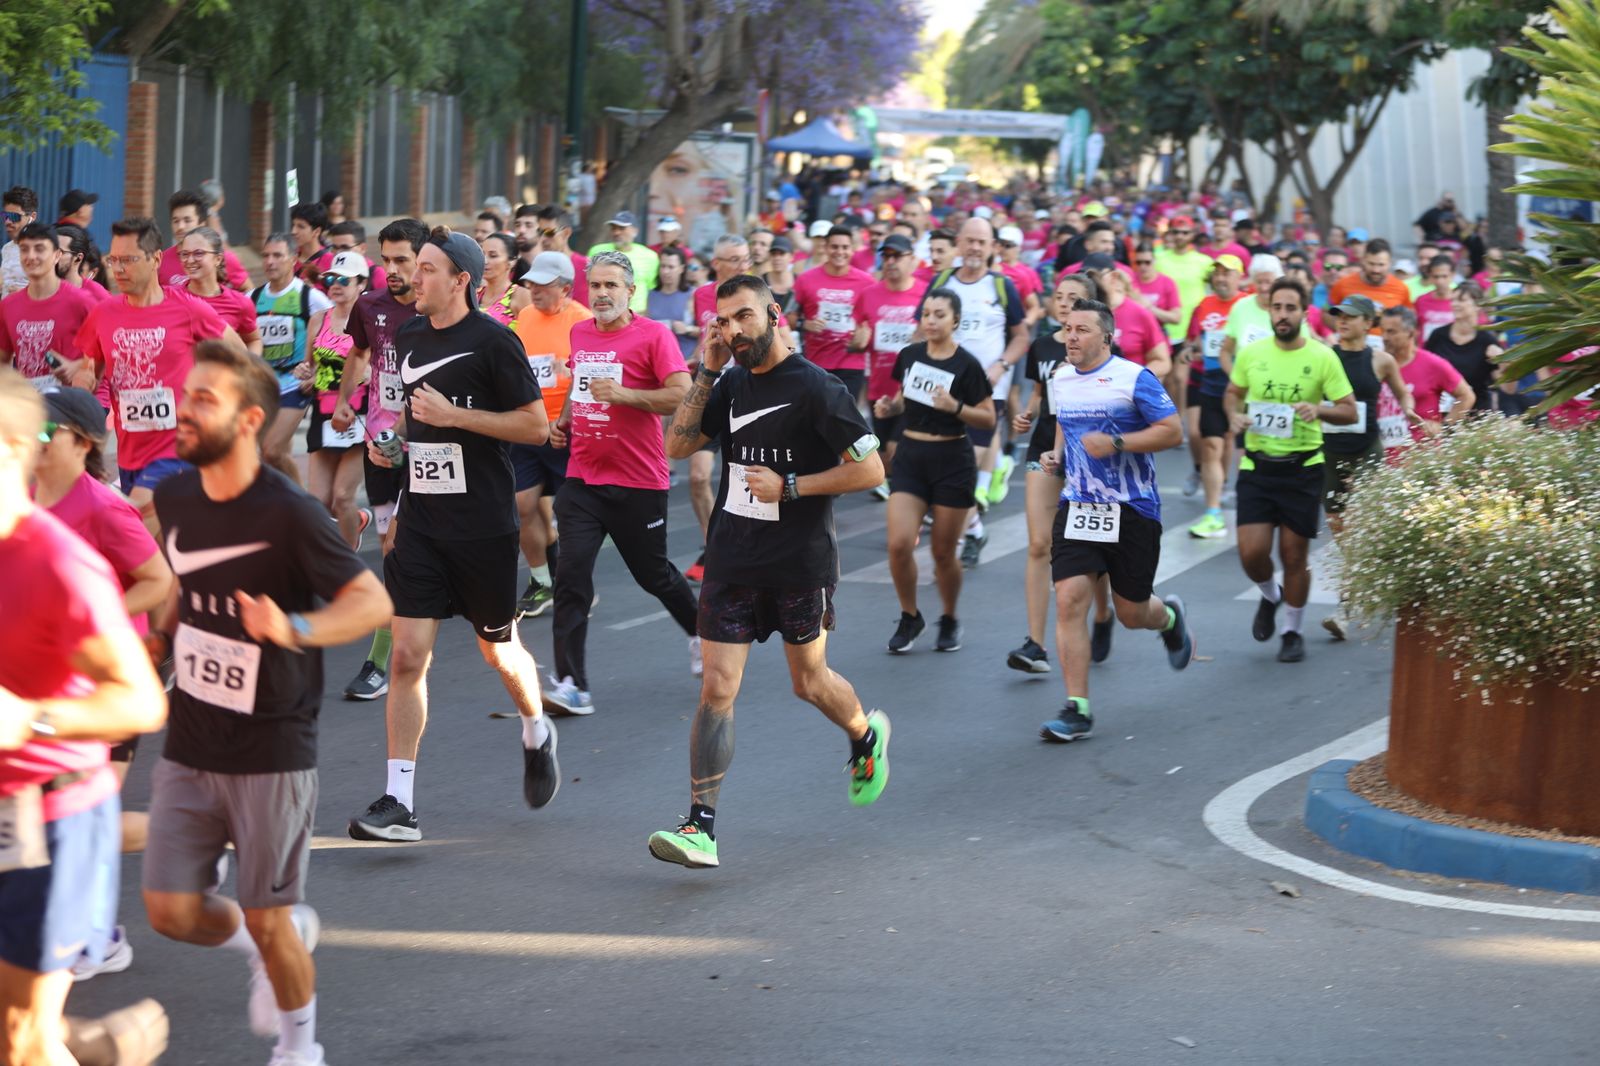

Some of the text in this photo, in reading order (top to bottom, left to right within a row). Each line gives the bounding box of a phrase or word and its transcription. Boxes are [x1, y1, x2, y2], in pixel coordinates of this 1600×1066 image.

[824, 311, 850, 323] 331
[961, 319, 980, 331] 97
[912, 375, 938, 393] 50
[126, 403, 170, 421] 240
[1254, 413, 1287, 430] 173
[741, 446, 793, 463] HLETE
[414, 461, 456, 481] 521
[1073, 514, 1114, 533] 355
[185, 653, 247, 691] 198
